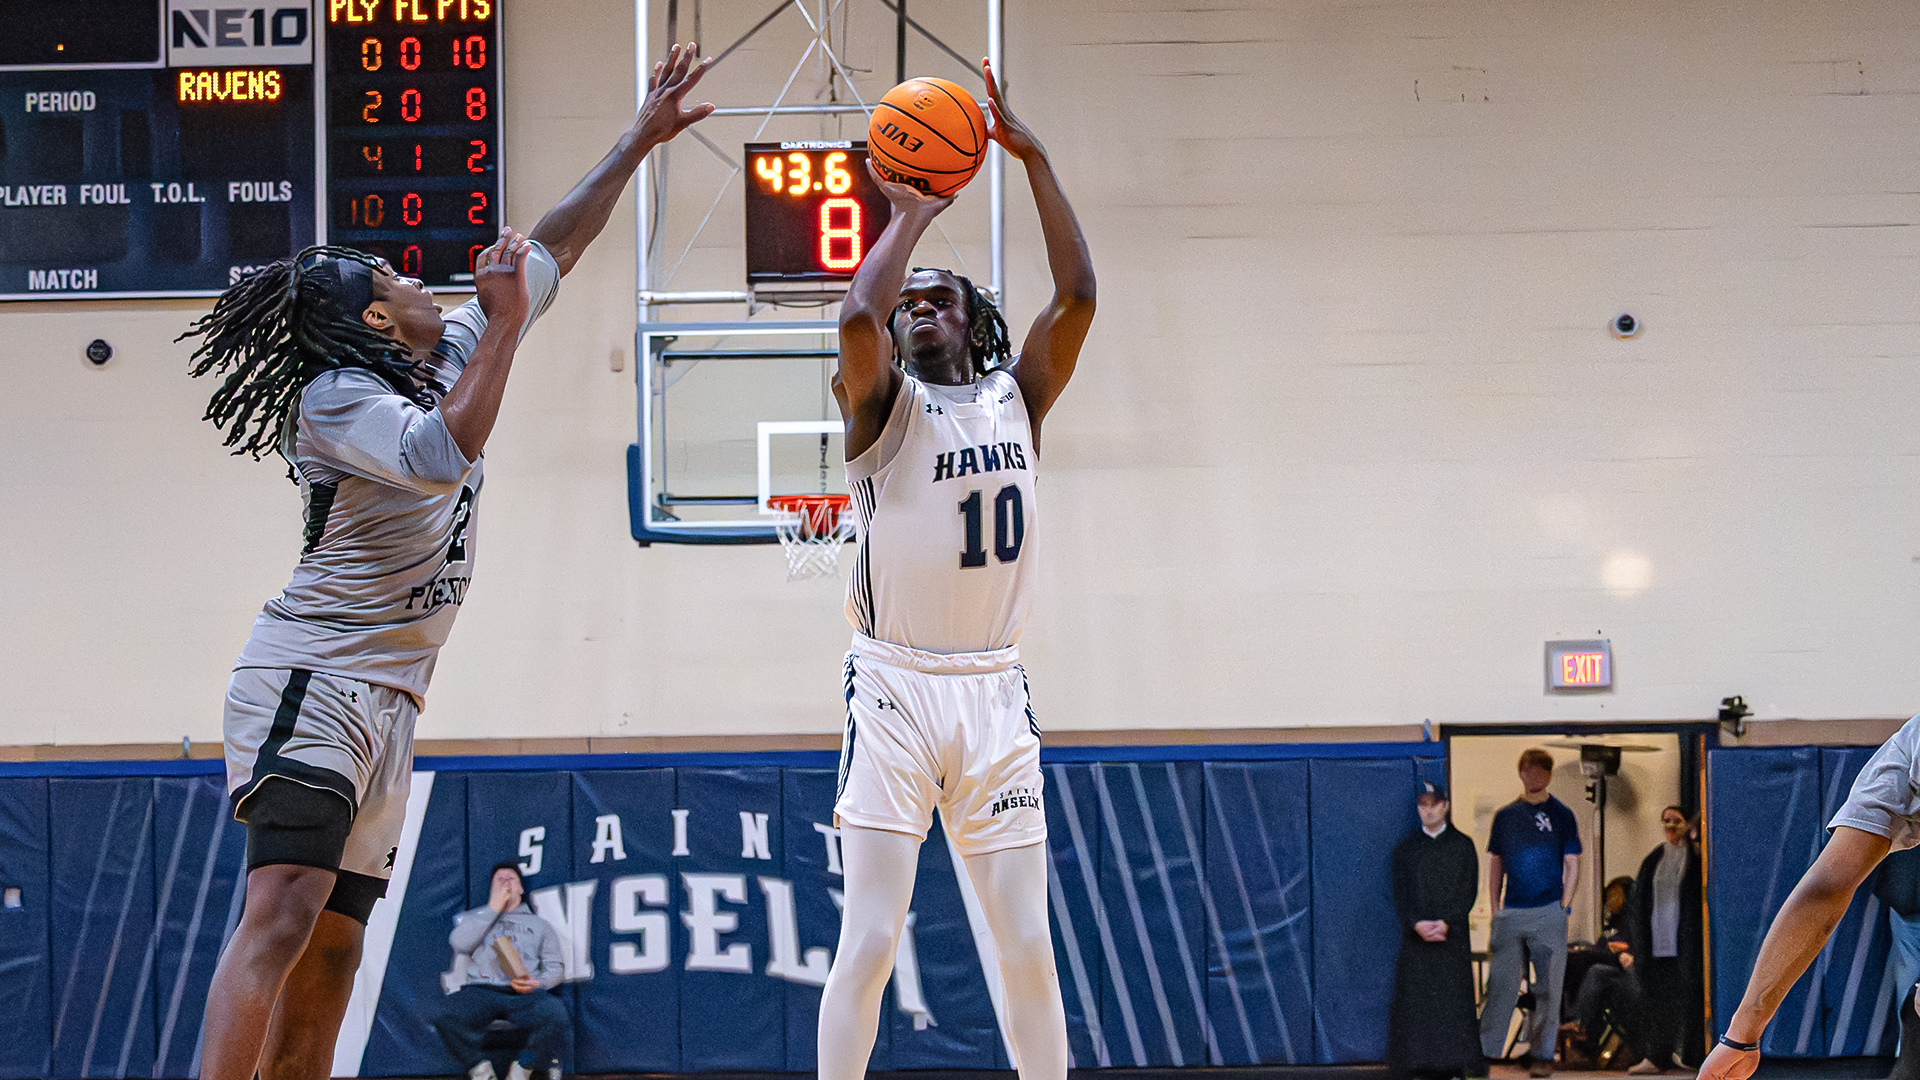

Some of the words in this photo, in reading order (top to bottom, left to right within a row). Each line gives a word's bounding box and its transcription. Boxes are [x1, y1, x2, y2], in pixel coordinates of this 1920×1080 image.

[172, 8, 308, 48] NE10
[331, 0, 379, 22] PLY
[395, 0, 428, 21] FL
[437, 0, 490, 20] PTS
[362, 38, 382, 71] 0
[400, 36, 421, 71] 0
[452, 35, 486, 69] 10
[25, 91, 96, 112] PERIOD
[179, 70, 280, 100] RAVENS
[362, 90, 383, 123] 2
[400, 88, 422, 122] 0
[466, 87, 486, 121] 8
[880, 122, 924, 152] EVO
[363, 146, 382, 170] 4
[415, 144, 422, 171] 1
[467, 139, 487, 173] 2
[756, 152, 851, 195] 43.6
[80, 184, 131, 204] FOUL
[151, 182, 206, 203] T.O.L.
[228, 180, 292, 203] FOULS
[351, 194, 384, 227] 10
[402, 192, 422, 226] 0
[467, 192, 488, 225] 2
[821, 198, 861, 269] 8
[28, 269, 98, 290] MATCH
[932, 442, 1027, 483] HAWKS
[958, 481, 1024, 570] 10
[405, 576, 472, 610] PIERC
[1562, 653, 1603, 684] EXIT
[517, 808, 843, 877] SAINT
[440, 872, 939, 1031] NSEL
